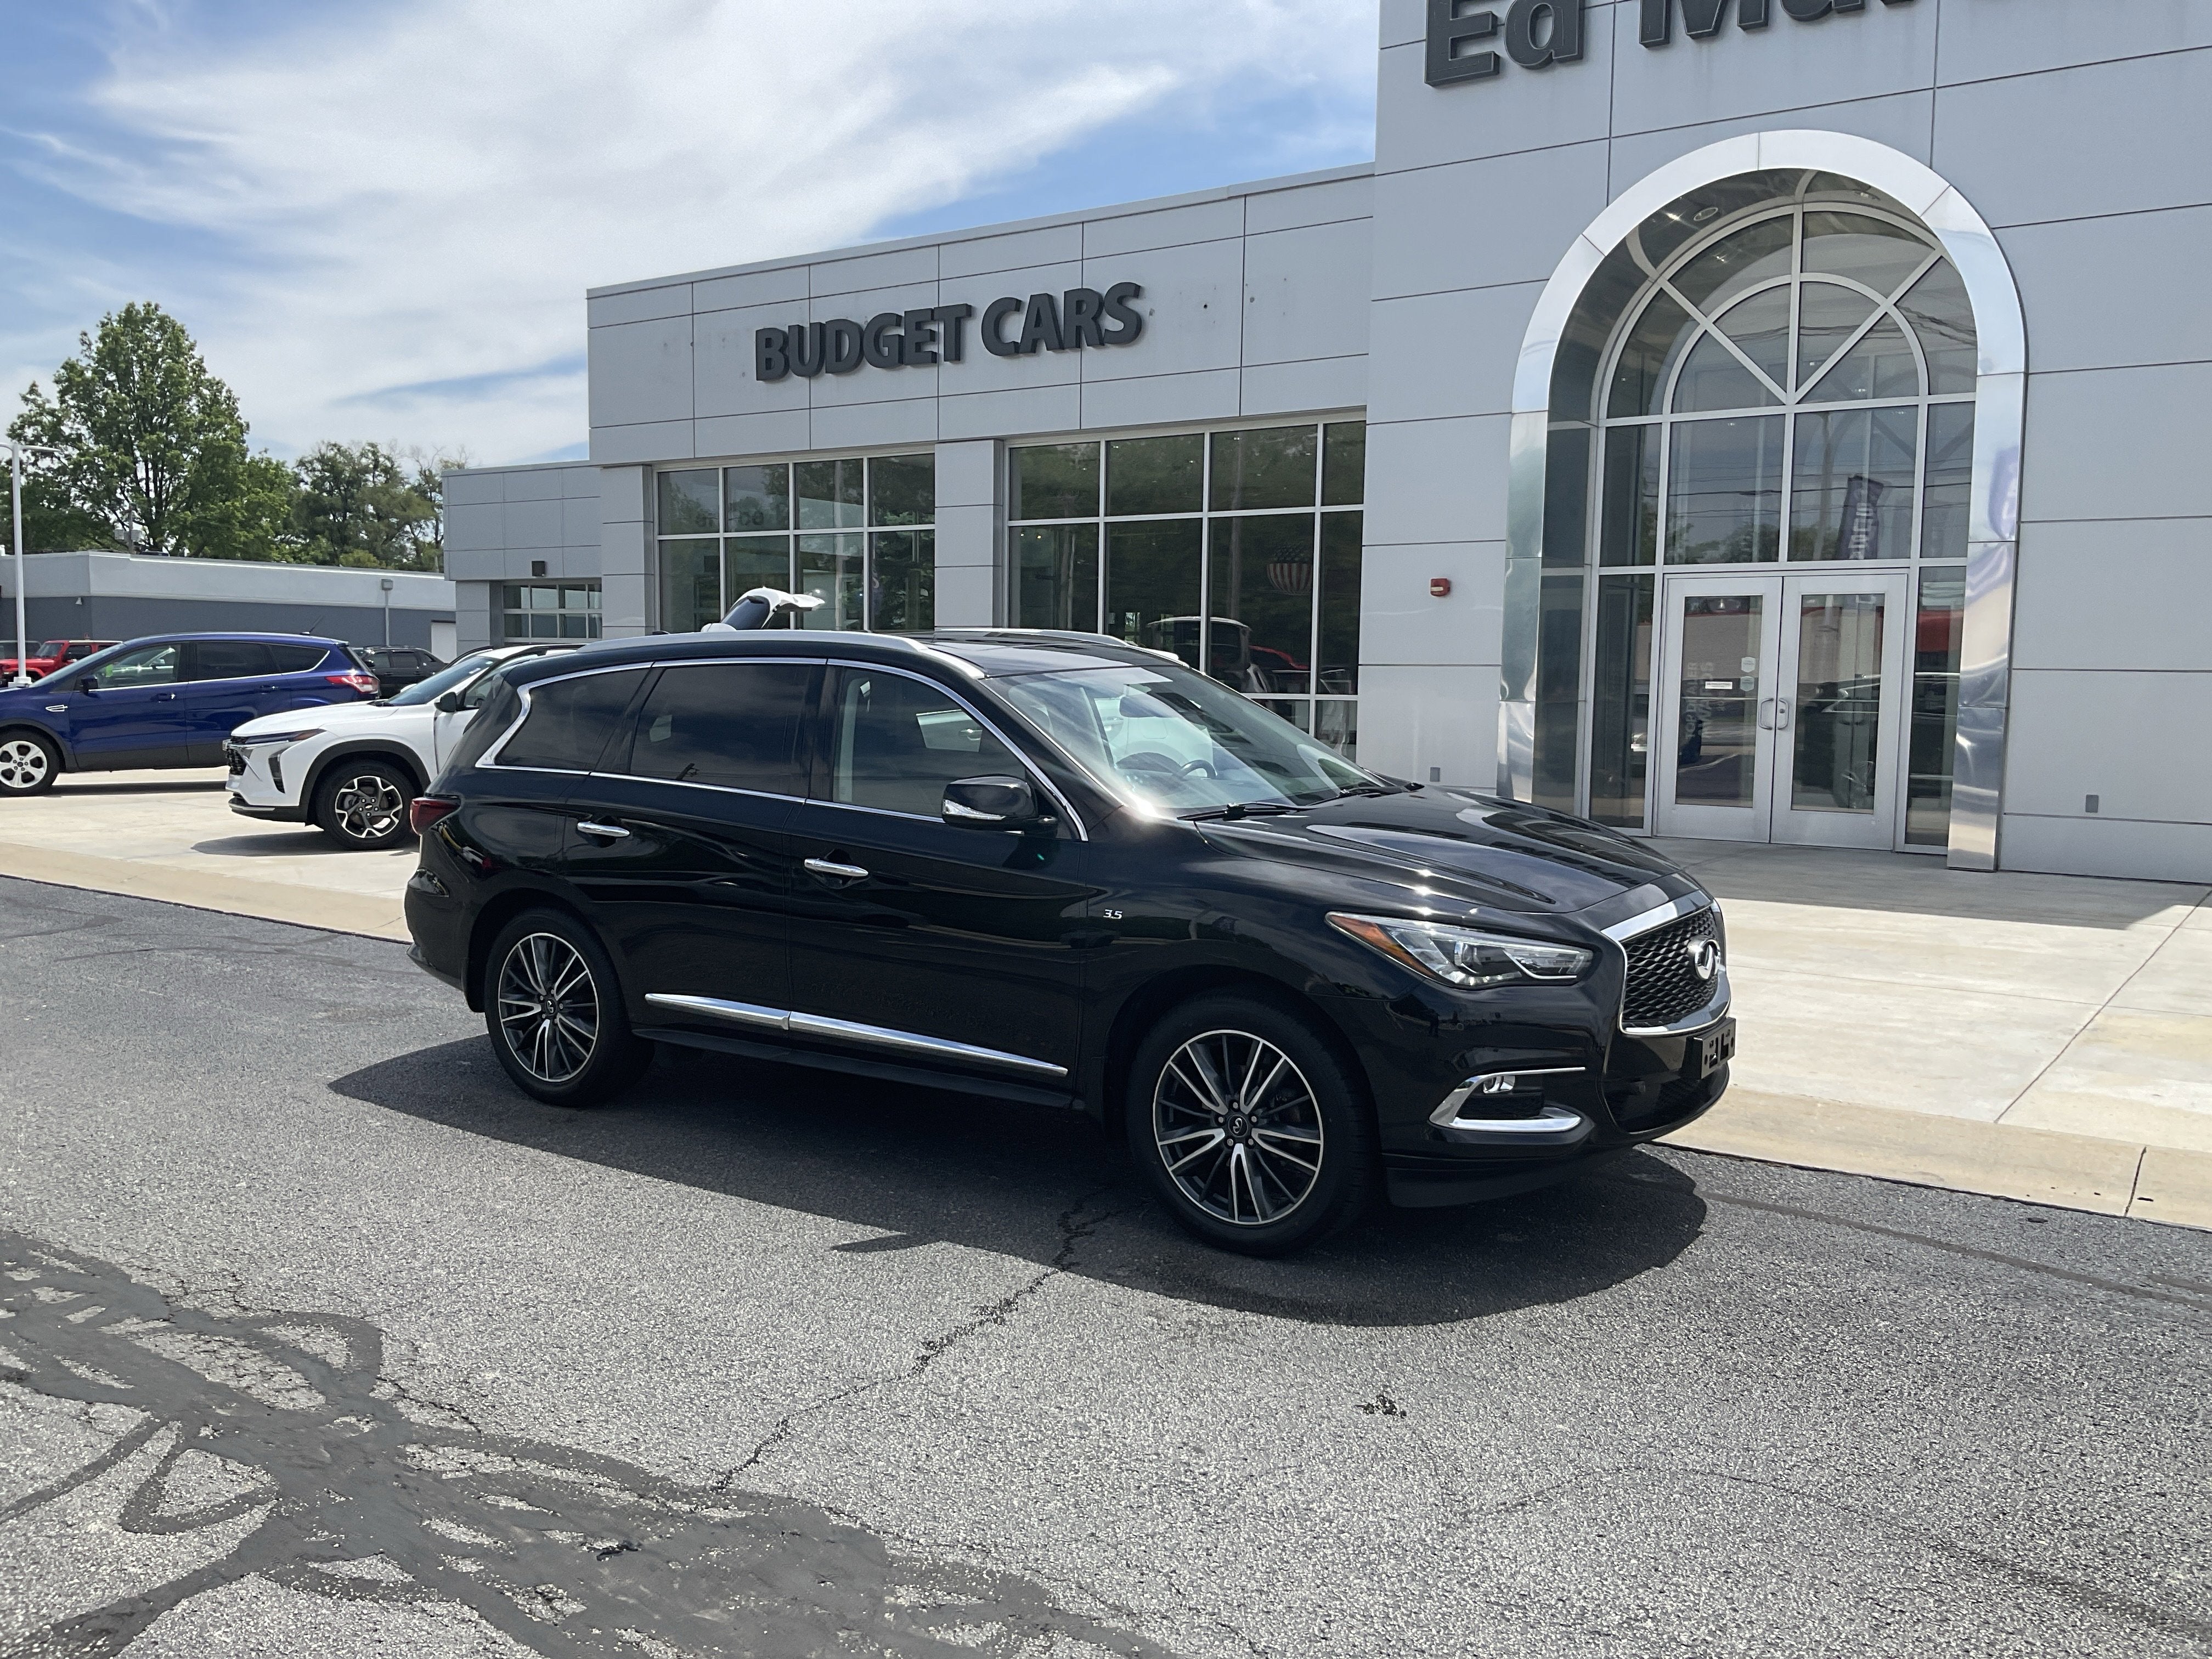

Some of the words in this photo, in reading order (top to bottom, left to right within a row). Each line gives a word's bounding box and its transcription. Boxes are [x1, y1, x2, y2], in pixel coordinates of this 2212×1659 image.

[756, 303, 972, 381] BUDGET
[981, 282, 1142, 356] CARS
[1103, 909, 1123, 919] 3.5
